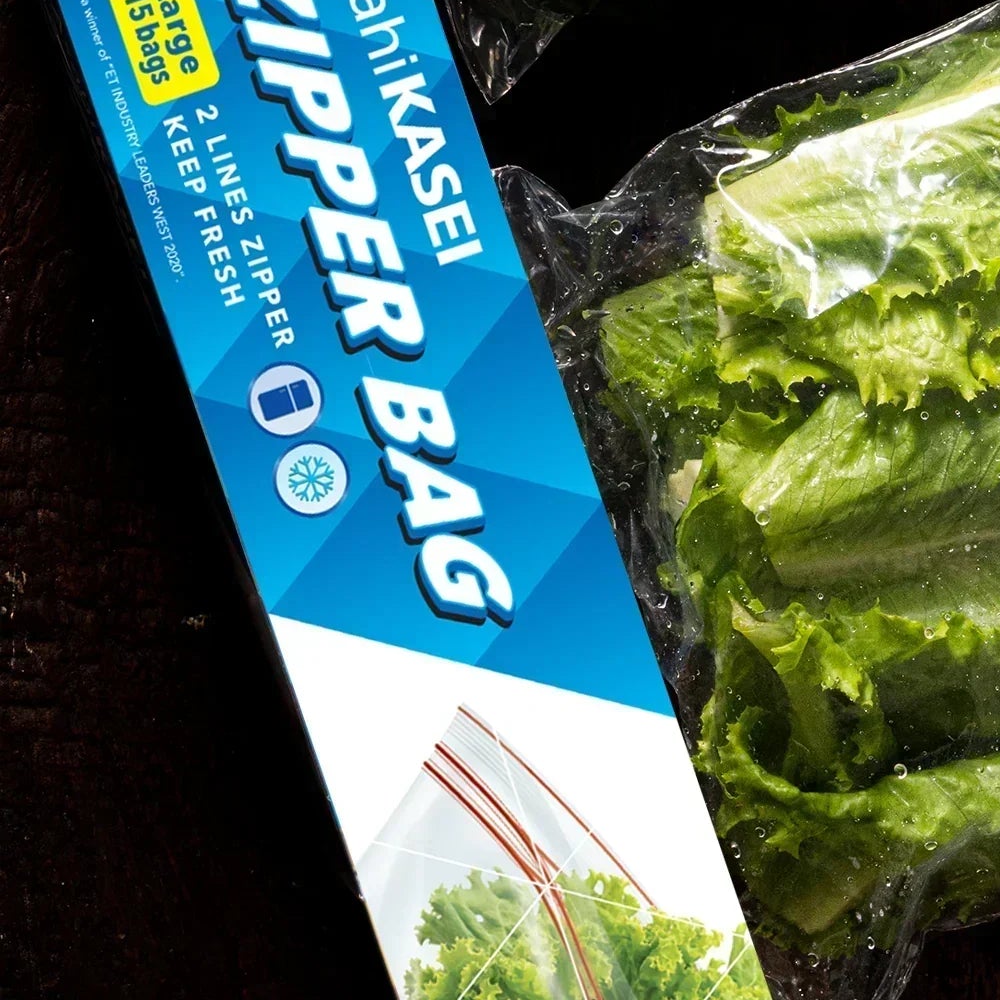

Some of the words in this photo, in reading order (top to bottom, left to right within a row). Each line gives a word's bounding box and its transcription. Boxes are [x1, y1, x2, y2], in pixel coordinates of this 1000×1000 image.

[135, 22, 171, 85] bags
[80, 0, 88, 7] a
[84, 8, 104, 47] winner
[98, 47, 112, 62] of
[111, 87, 142, 149] INDUSTRY
[132, 150, 161, 206] LEADERS
[152, 206, 174, 241] WEST
[195, 104, 219, 125] 2
[162, 114, 208, 195] KEEP
[193, 205, 247, 308] FRESH
[206, 133, 255, 226] LINES
[239, 234, 296, 350] ZIPPER
[354, 375, 516, 629] BAG
